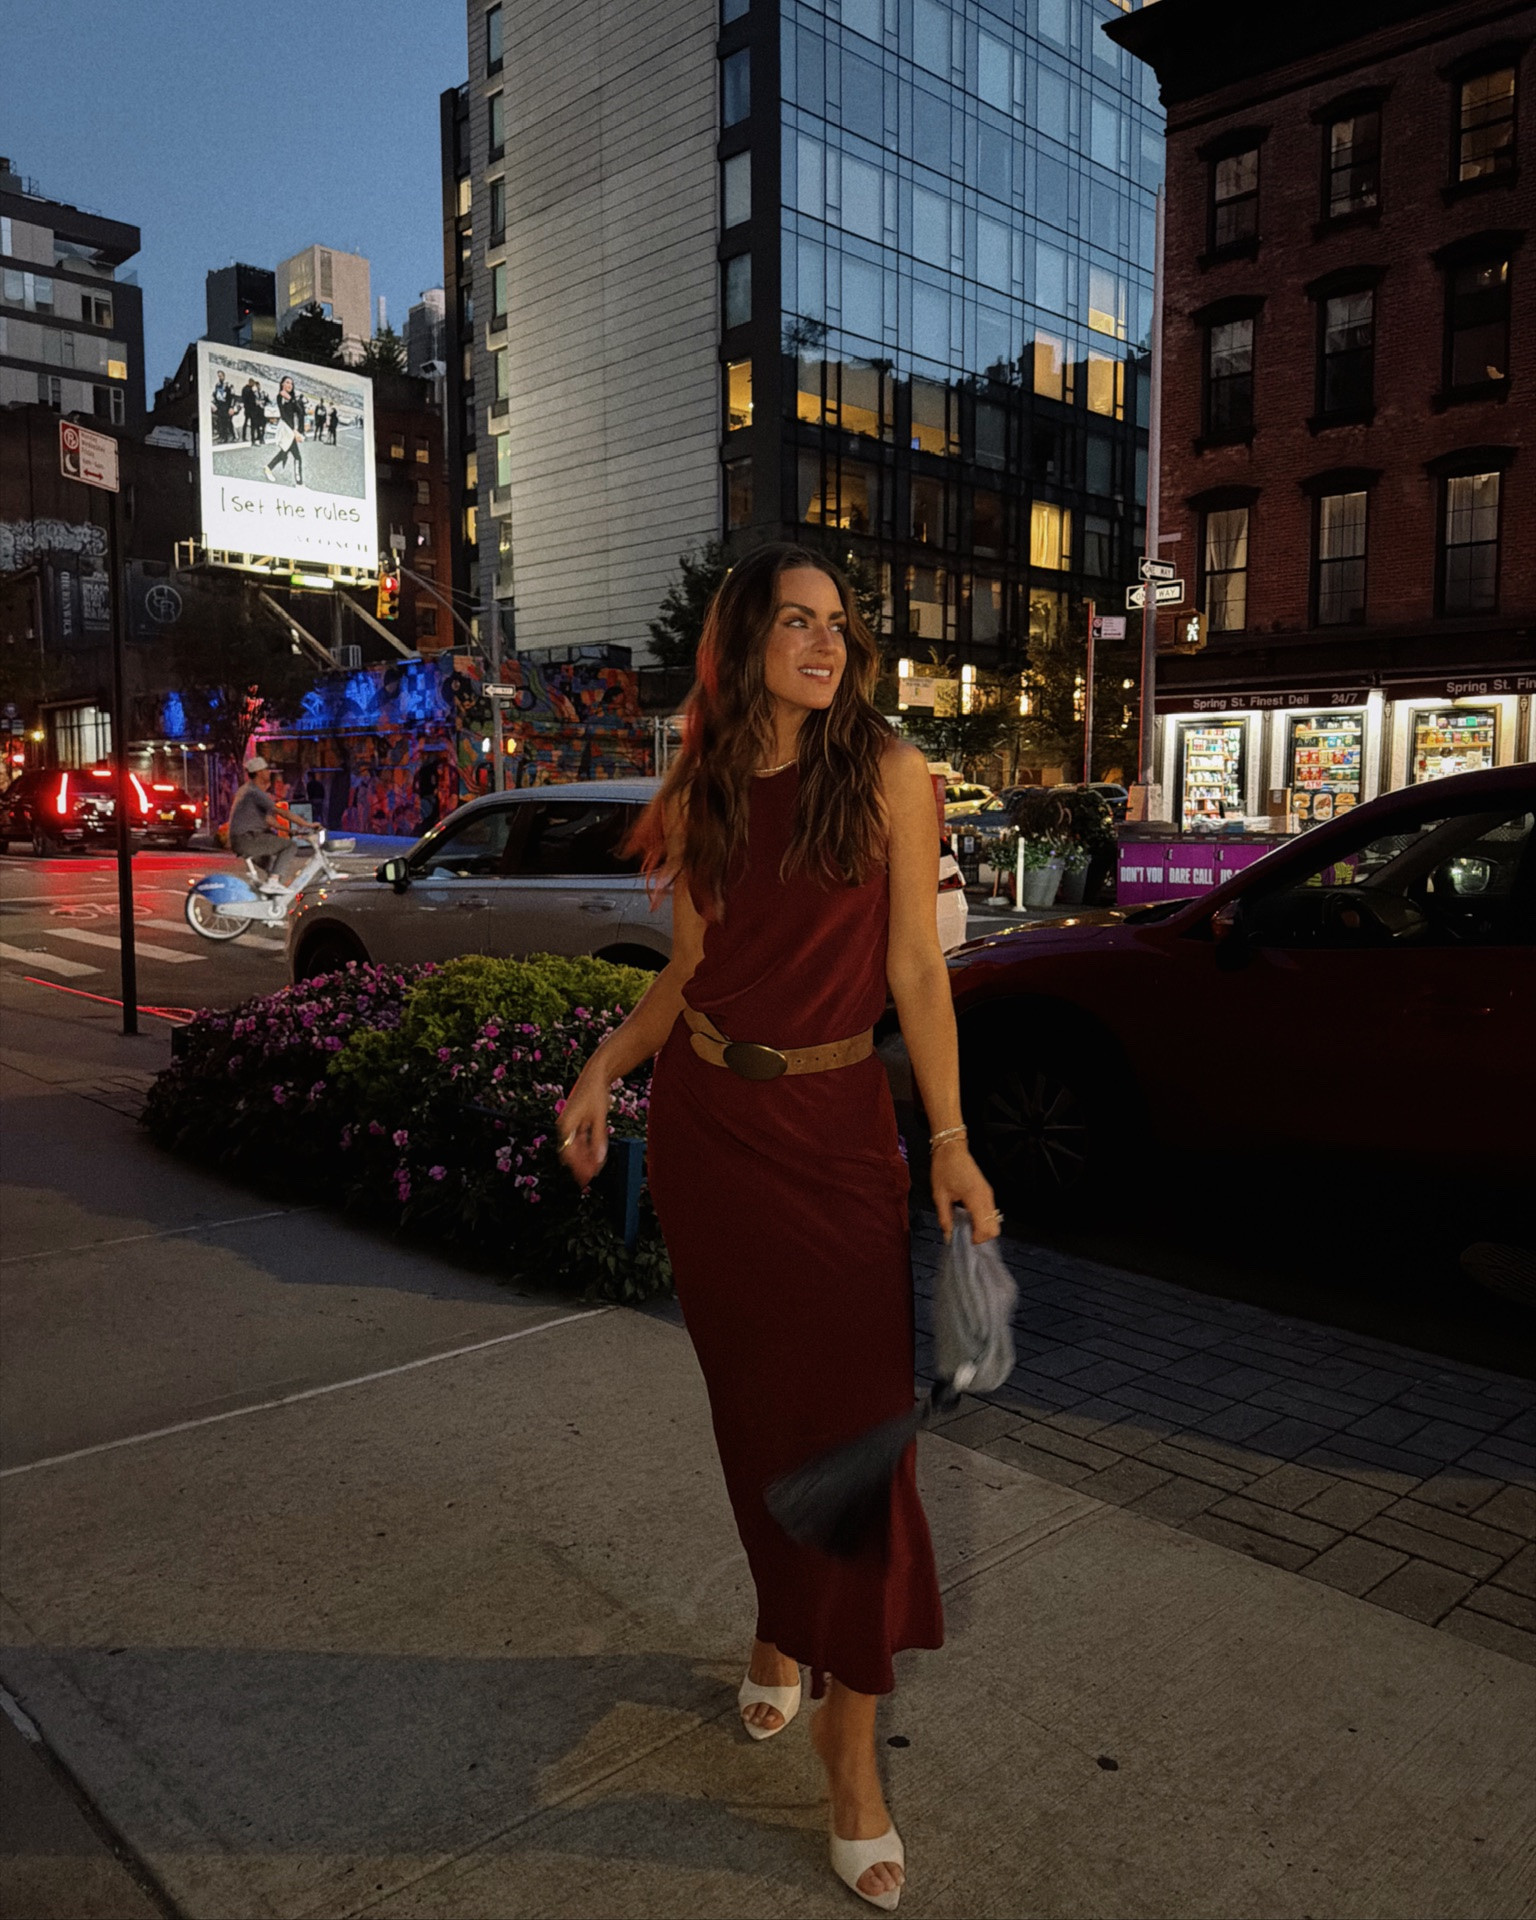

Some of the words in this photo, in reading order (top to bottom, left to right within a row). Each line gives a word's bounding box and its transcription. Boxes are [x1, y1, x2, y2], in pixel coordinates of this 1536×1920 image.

[221, 487, 225, 511] I
[231, 496, 264, 514] set
[276, 498, 305, 518] the
[315, 502, 360, 522] rules
[1144, 565, 1155, 575] ONE
[1158, 589, 1176, 598] WAY
[1446, 681, 1487, 695] Spring
[1493, 678, 1511, 690] St.
[1193, 699, 1227, 710] Spring
[1231, 697, 1245, 707] St.
[1250, 695, 1283, 707] Finest
[1288, 694, 1309, 705] Deli
[1331, 692, 1358, 704] 24/7
[1120, 866, 1145, 883] DON'T
[1146, 867, 1164, 883] YOU
[1169, 868, 1191, 884] DARE
[1192, 868, 1214, 885] CALL
